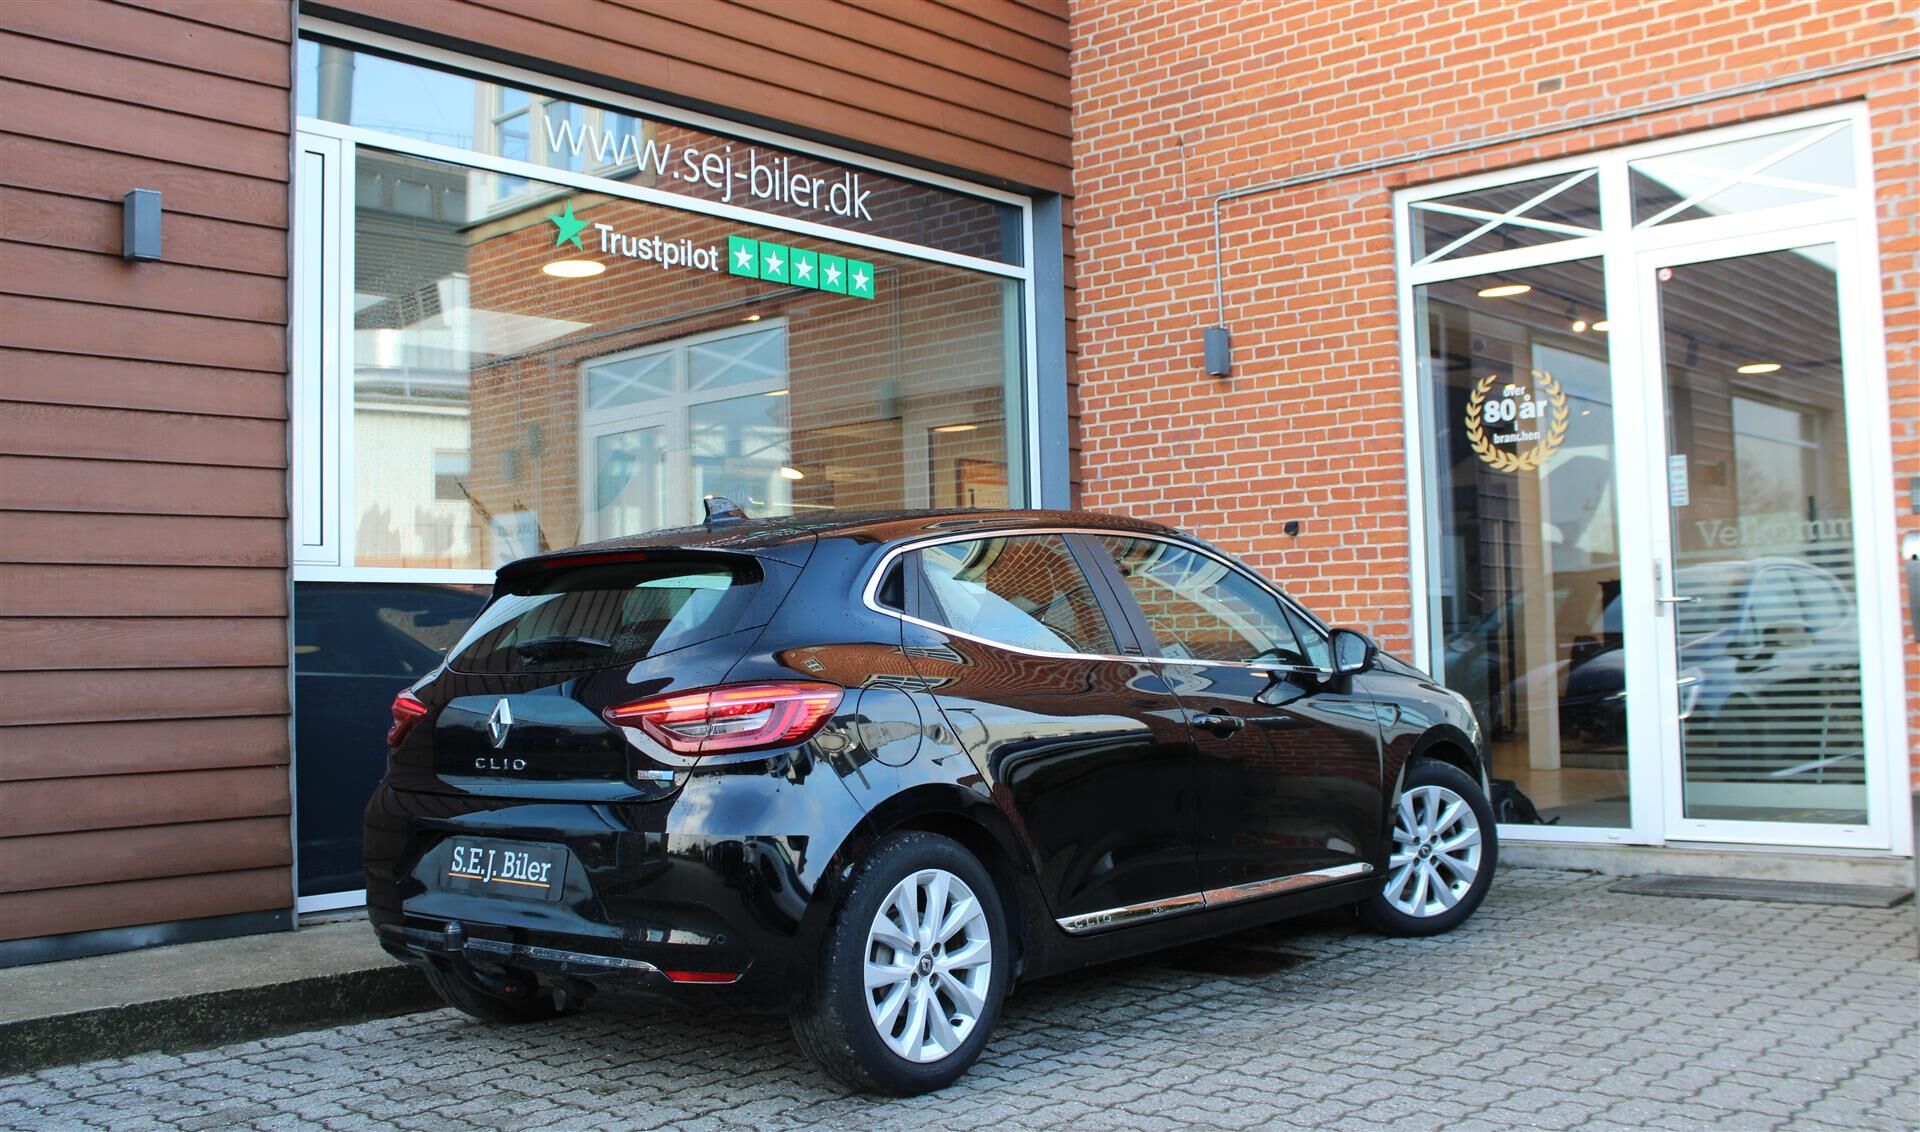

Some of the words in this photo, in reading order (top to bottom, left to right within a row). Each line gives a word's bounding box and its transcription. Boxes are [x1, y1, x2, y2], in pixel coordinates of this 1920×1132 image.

[545, 115, 873, 222] www.sej-biler.dk
[594, 222, 719, 272] Trustpilot
[1503, 386, 1526, 397] over
[1484, 398, 1516, 423] 80
[1519, 394, 1547, 419] år
[1493, 431, 1540, 444] branchen
[475, 757, 527, 770] CLIO
[451, 845, 497, 883] S.E.J.
[501, 850, 552, 883] Biler
[1075, 914, 1111, 928] CLIO
